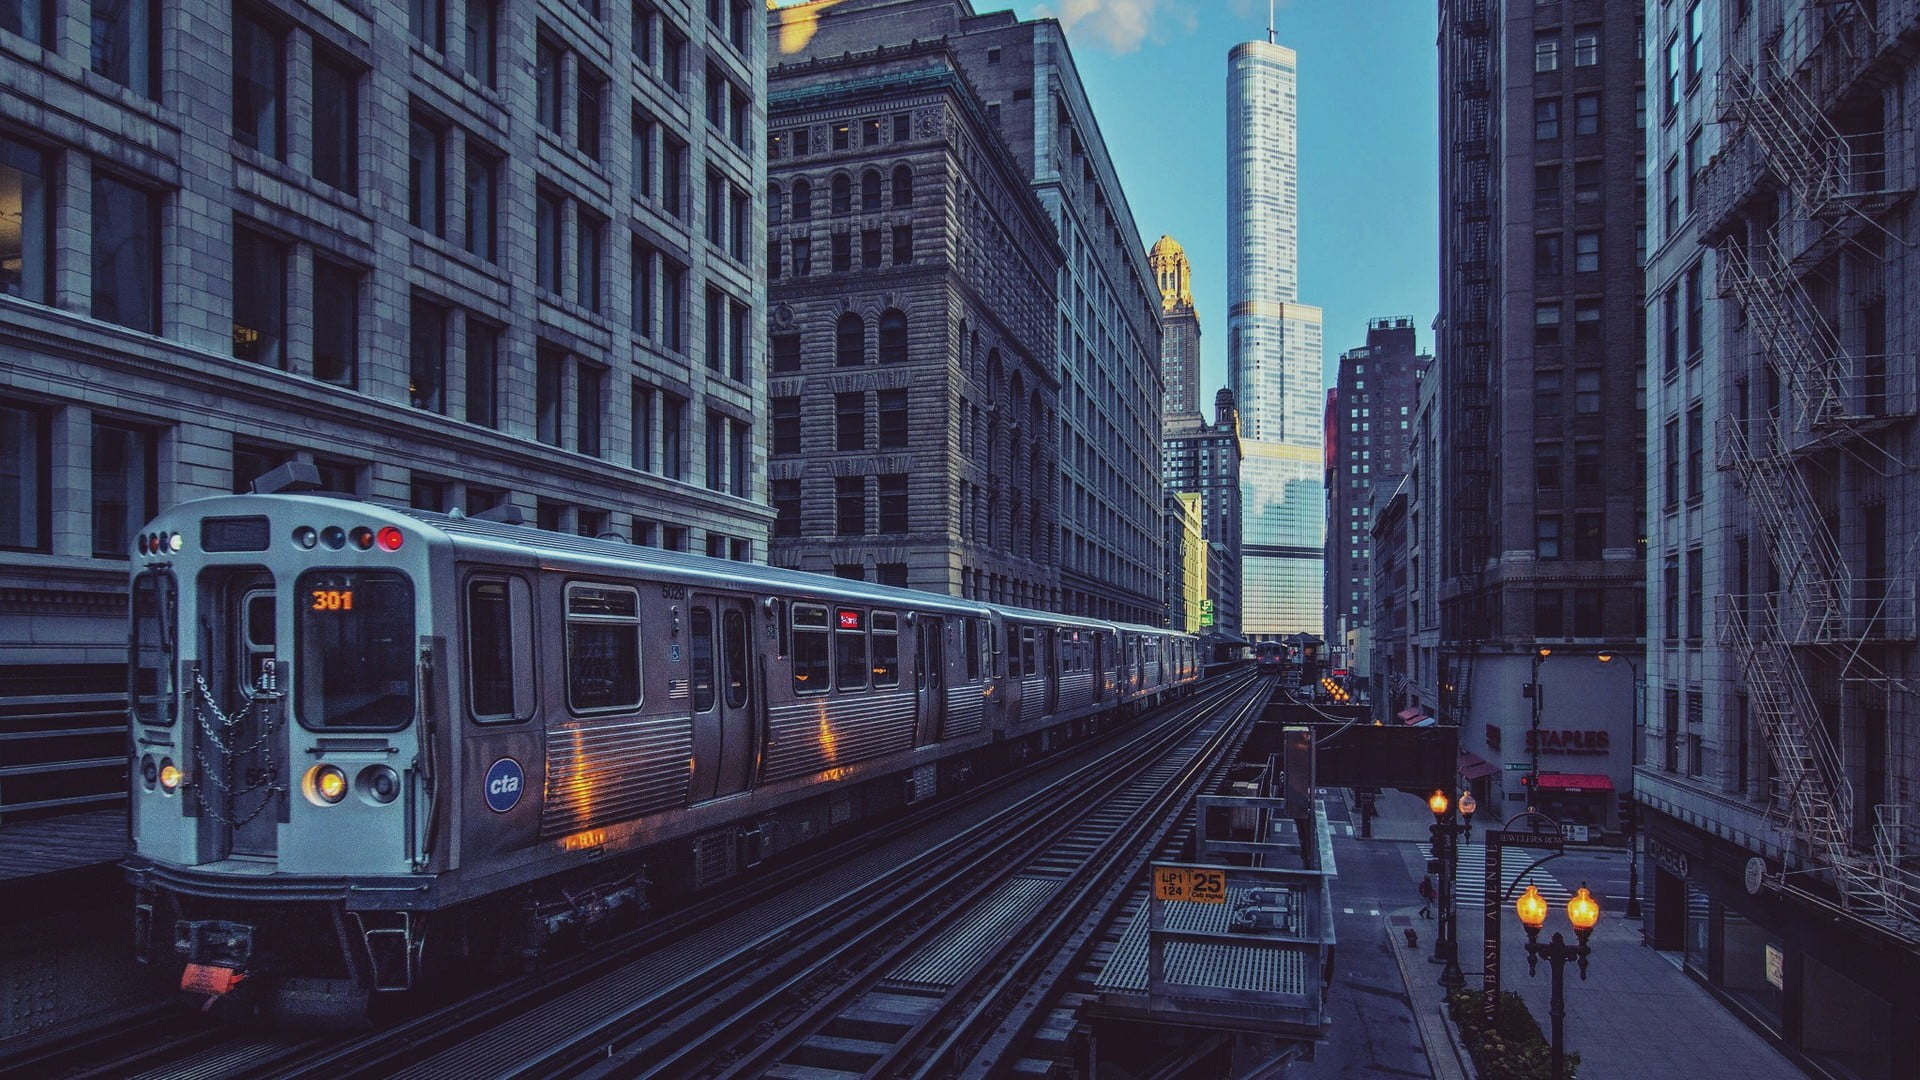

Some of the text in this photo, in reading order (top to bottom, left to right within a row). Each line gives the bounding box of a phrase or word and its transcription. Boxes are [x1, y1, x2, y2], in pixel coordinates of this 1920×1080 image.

[312, 591, 352, 609] 301
[1330, 645, 1346, 653] ARK
[1525, 730, 1610, 749] STAPLES
[490, 774, 519, 795] cta
[1161, 886, 1182, 896] 124
[1193, 872, 1222, 893] 25
